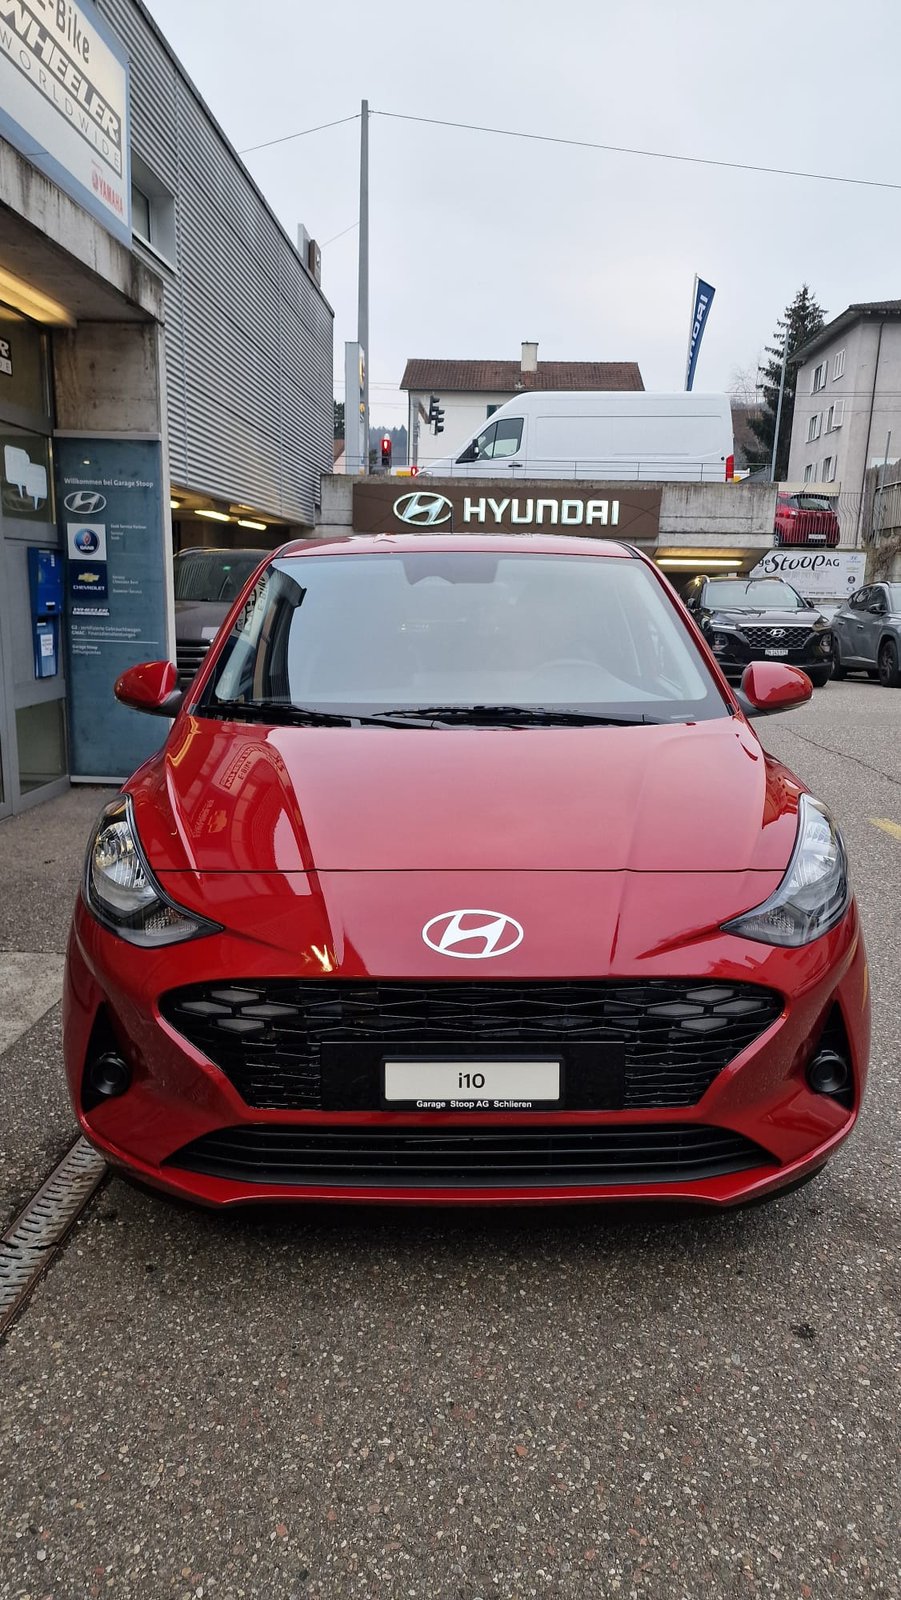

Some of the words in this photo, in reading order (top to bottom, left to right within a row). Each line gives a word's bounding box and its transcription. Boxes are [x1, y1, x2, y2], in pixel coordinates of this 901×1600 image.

[0, 30, 121, 170] WORLDWIDE
[98, 175, 124, 217] YAMAHA
[64, 477, 102, 486] Willkommen
[103, 478, 113, 486] bei
[113, 479, 135, 488] Garage
[136, 480, 154, 489] Stoop
[464, 497, 620, 526] HYUNDAI
[765, 553, 826, 574] Stoop
[825, 558, 840, 567] AG
[458, 1072, 485, 1089] i10
[416, 1100, 446, 1109] Garage
[450, 1100, 475, 1109] Stoop
[476, 1100, 489, 1108] AG
[493, 1100, 532, 1108] Schlieren
